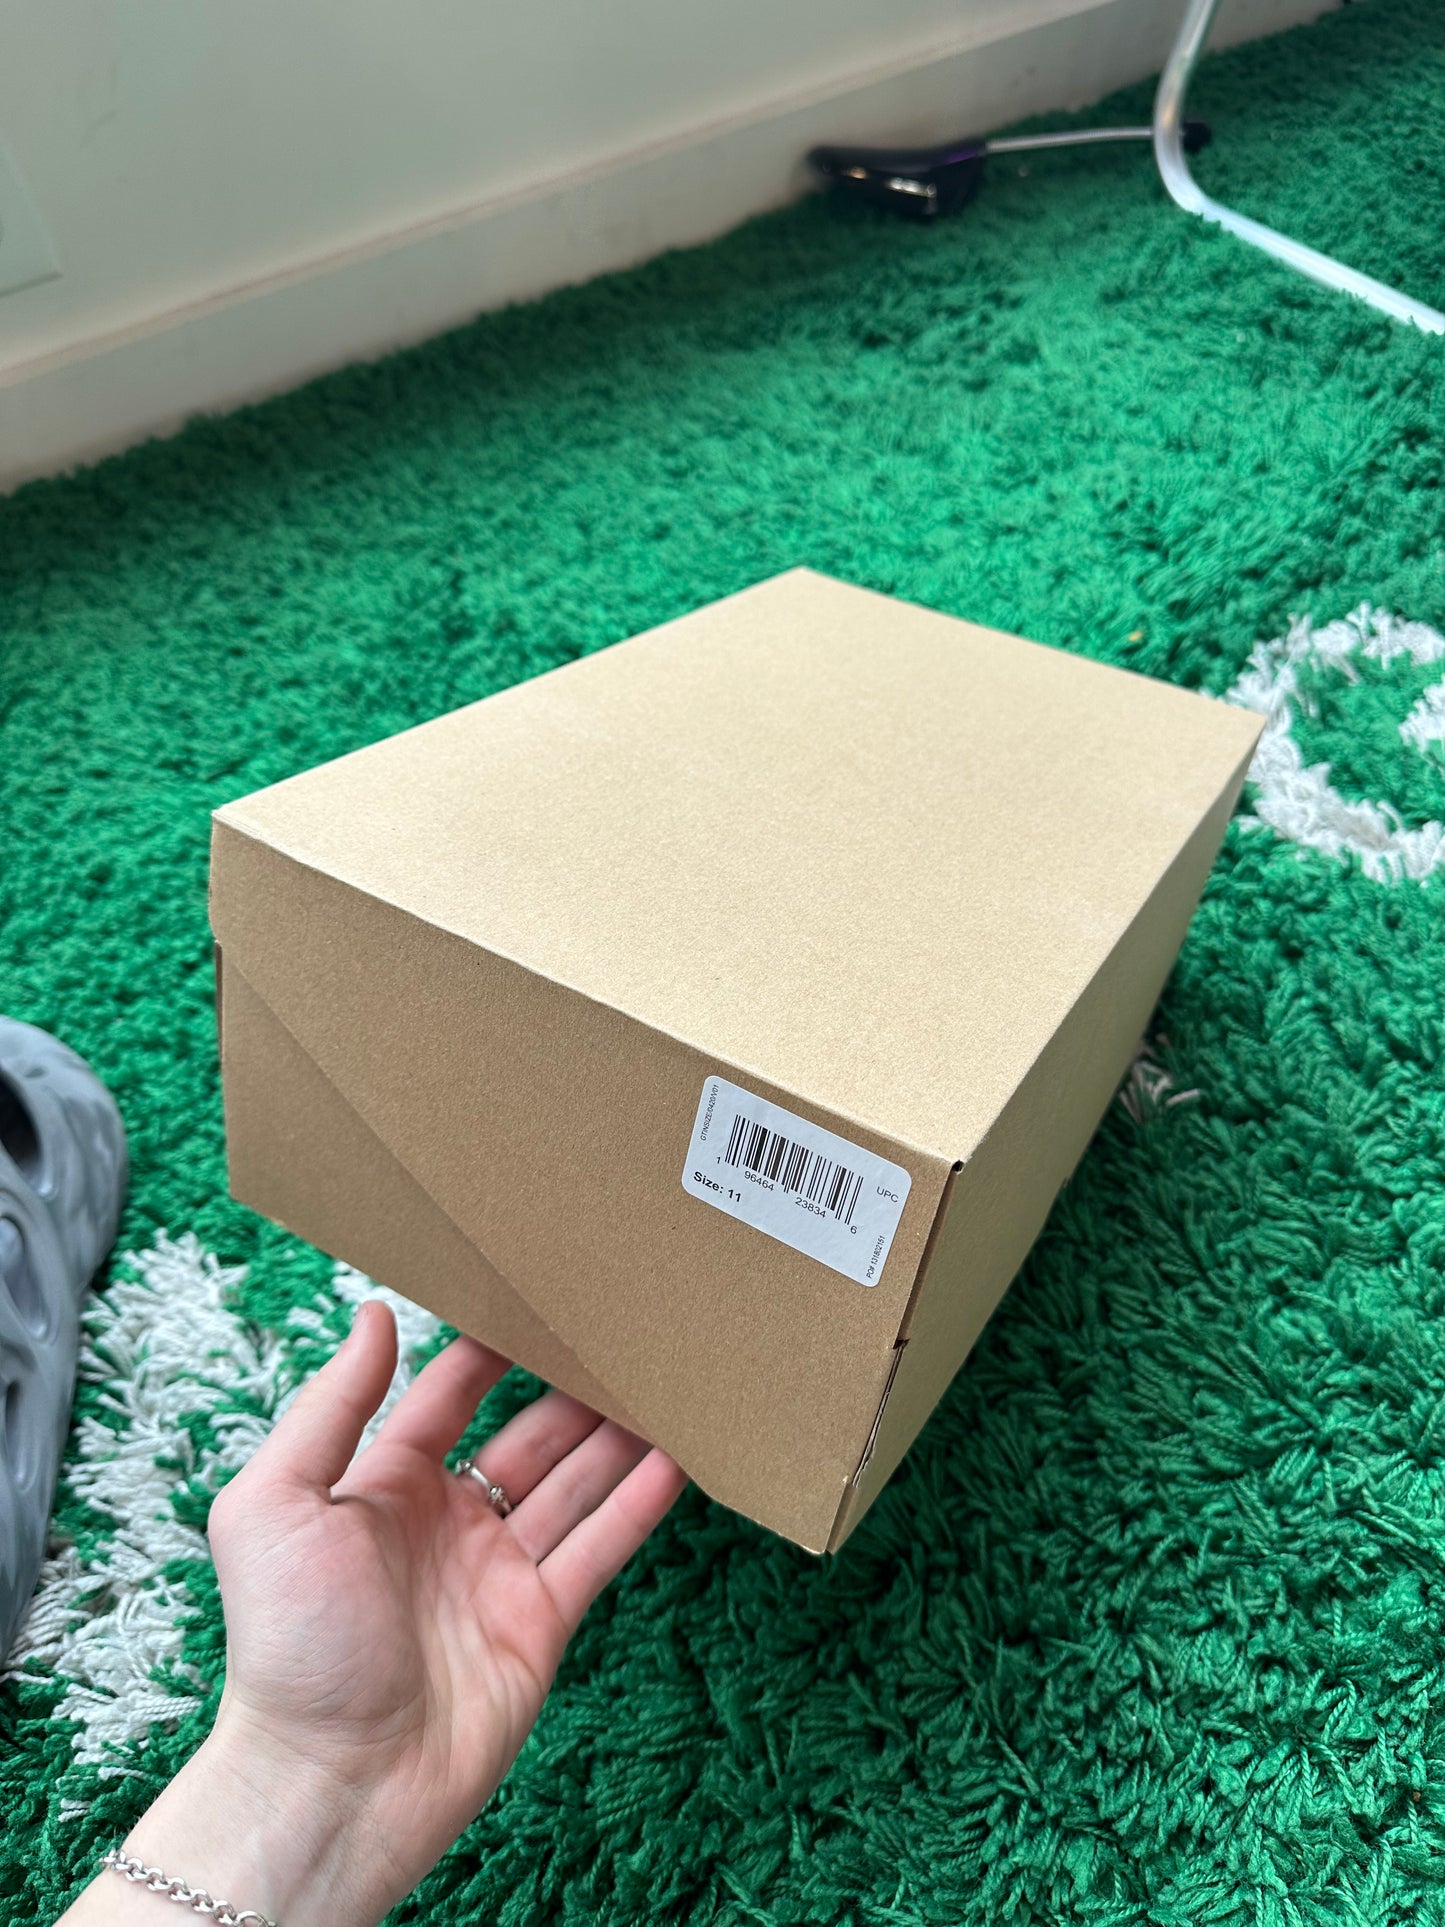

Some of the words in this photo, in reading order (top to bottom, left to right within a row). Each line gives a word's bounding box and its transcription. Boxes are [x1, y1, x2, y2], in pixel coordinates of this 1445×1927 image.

[693, 1171, 724, 1194] Size:
[727, 1188, 742, 1202] 11
[716, 1156, 721, 1165] 1
[743, 1170, 775, 1192] 96464
[794, 1197, 827, 1218] 23834
[850, 1225, 858, 1234] 6
[876, 1186, 899, 1203] UPC
